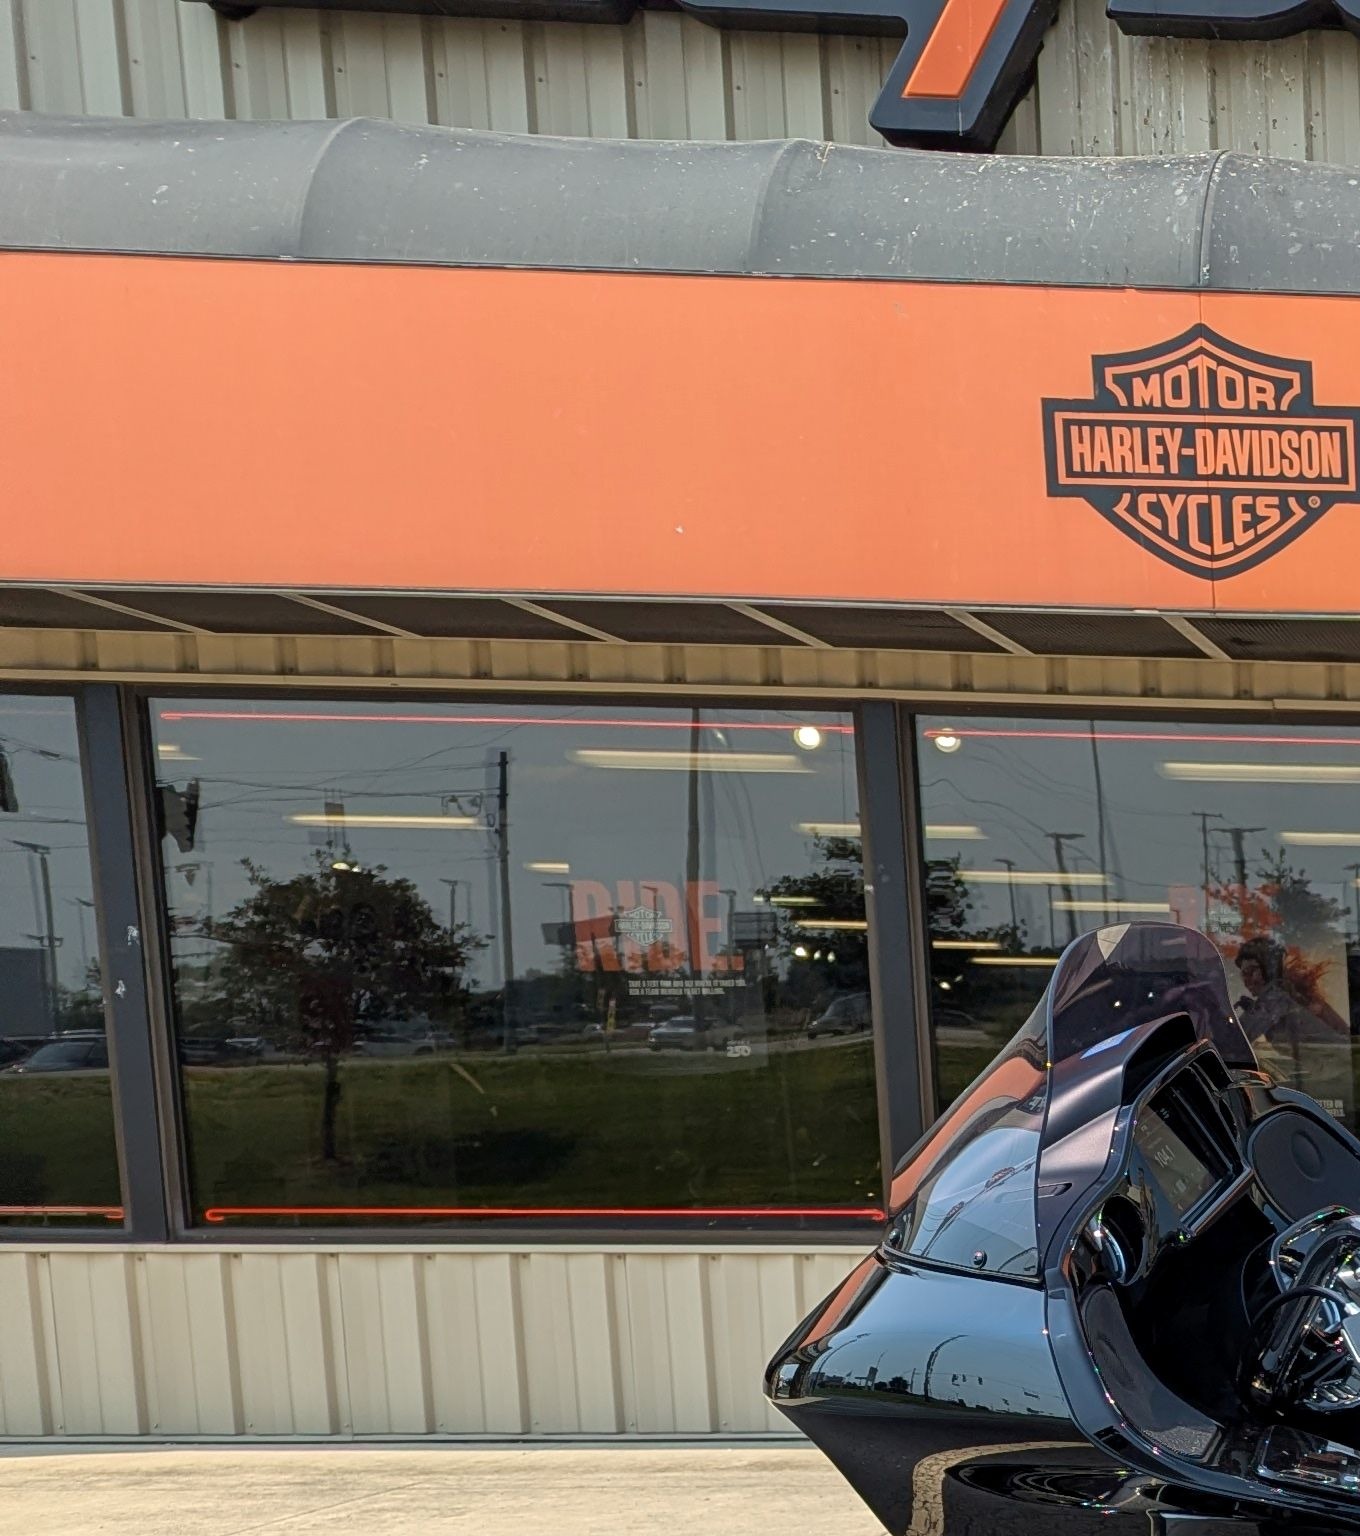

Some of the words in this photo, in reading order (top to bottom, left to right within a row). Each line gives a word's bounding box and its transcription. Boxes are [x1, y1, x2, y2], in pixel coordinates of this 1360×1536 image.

[1131, 355, 1276, 411] MOTOR
[1069, 424, 1343, 479] HARLEY-DAVIDSON
[1137, 492, 1281, 556] CYCLES
